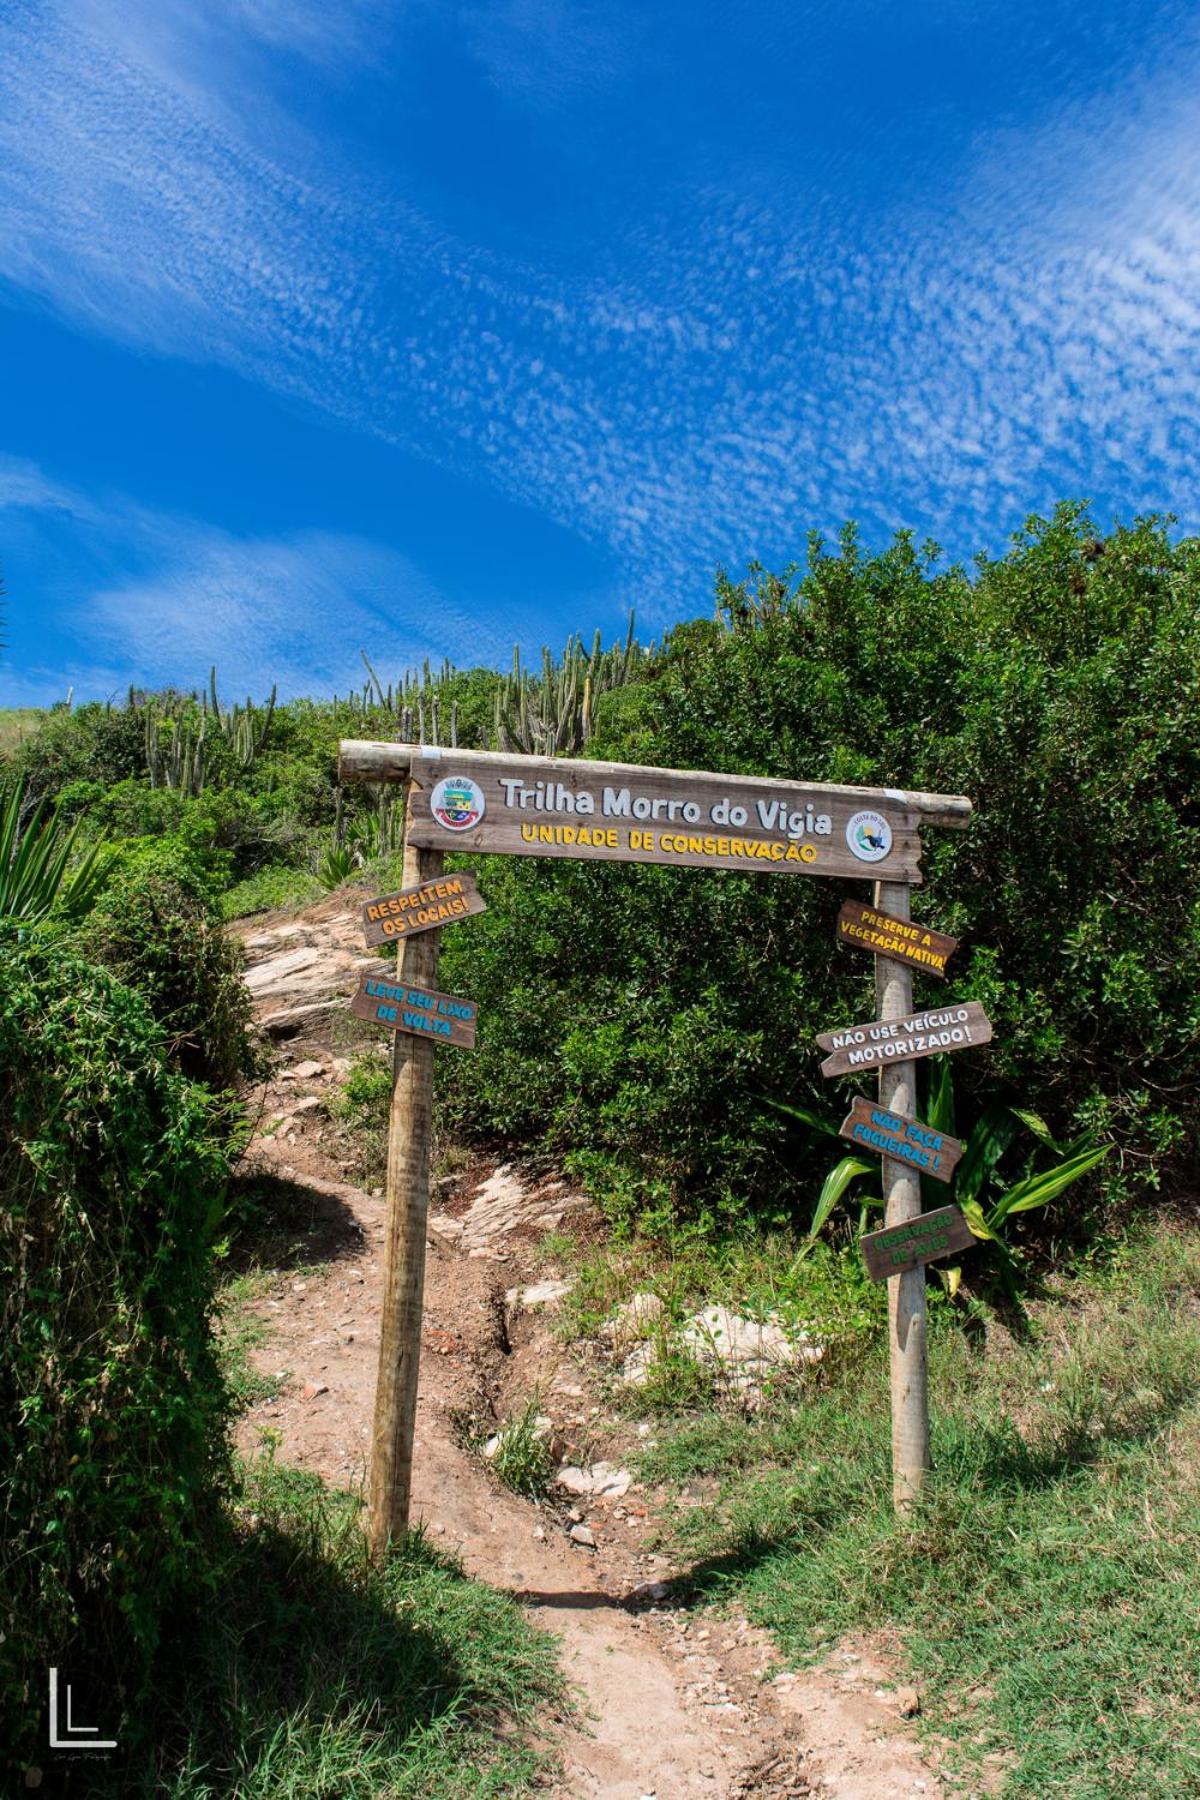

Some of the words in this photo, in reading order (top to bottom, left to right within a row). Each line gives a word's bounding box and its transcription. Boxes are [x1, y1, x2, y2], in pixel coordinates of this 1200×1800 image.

[500, 778, 594, 815] Trilha
[603, 787, 701, 823] Morro
[711, 798, 748, 827] do
[757, 800, 832, 839] Vigia
[521, 823, 618, 848] UNIDADE
[628, 831, 655, 850] DE
[660, 834, 817, 863] CONSERVAÇÃO
[367, 879, 462, 922] RESPEITEM
[382, 918, 406, 936] OS
[407, 896, 470, 928] LOCAIS!
[840, 921, 905, 953] VEGETAÇÃO
[905, 945, 947, 971] NATIVA!
[860, 911, 919, 941] PRESERVE
[921, 934, 931, 946] A
[365, 979, 406, 1001] LEVE
[408, 990, 435, 1010] SEU
[437, 1000, 473, 1020] LIXO
[377, 1005, 397, 1022] DE
[402, 1011, 452, 1036] VOLTA
[832, 1030, 865, 1049] NÃO
[870, 1026, 898, 1040] USE
[903, 1009, 969, 1033] VEÍCULO
[852, 1123, 930, 1168] FOGUEIRAS
[870, 1110, 901, 1133] NÃO
[905, 1125, 943, 1151] FAÇA
